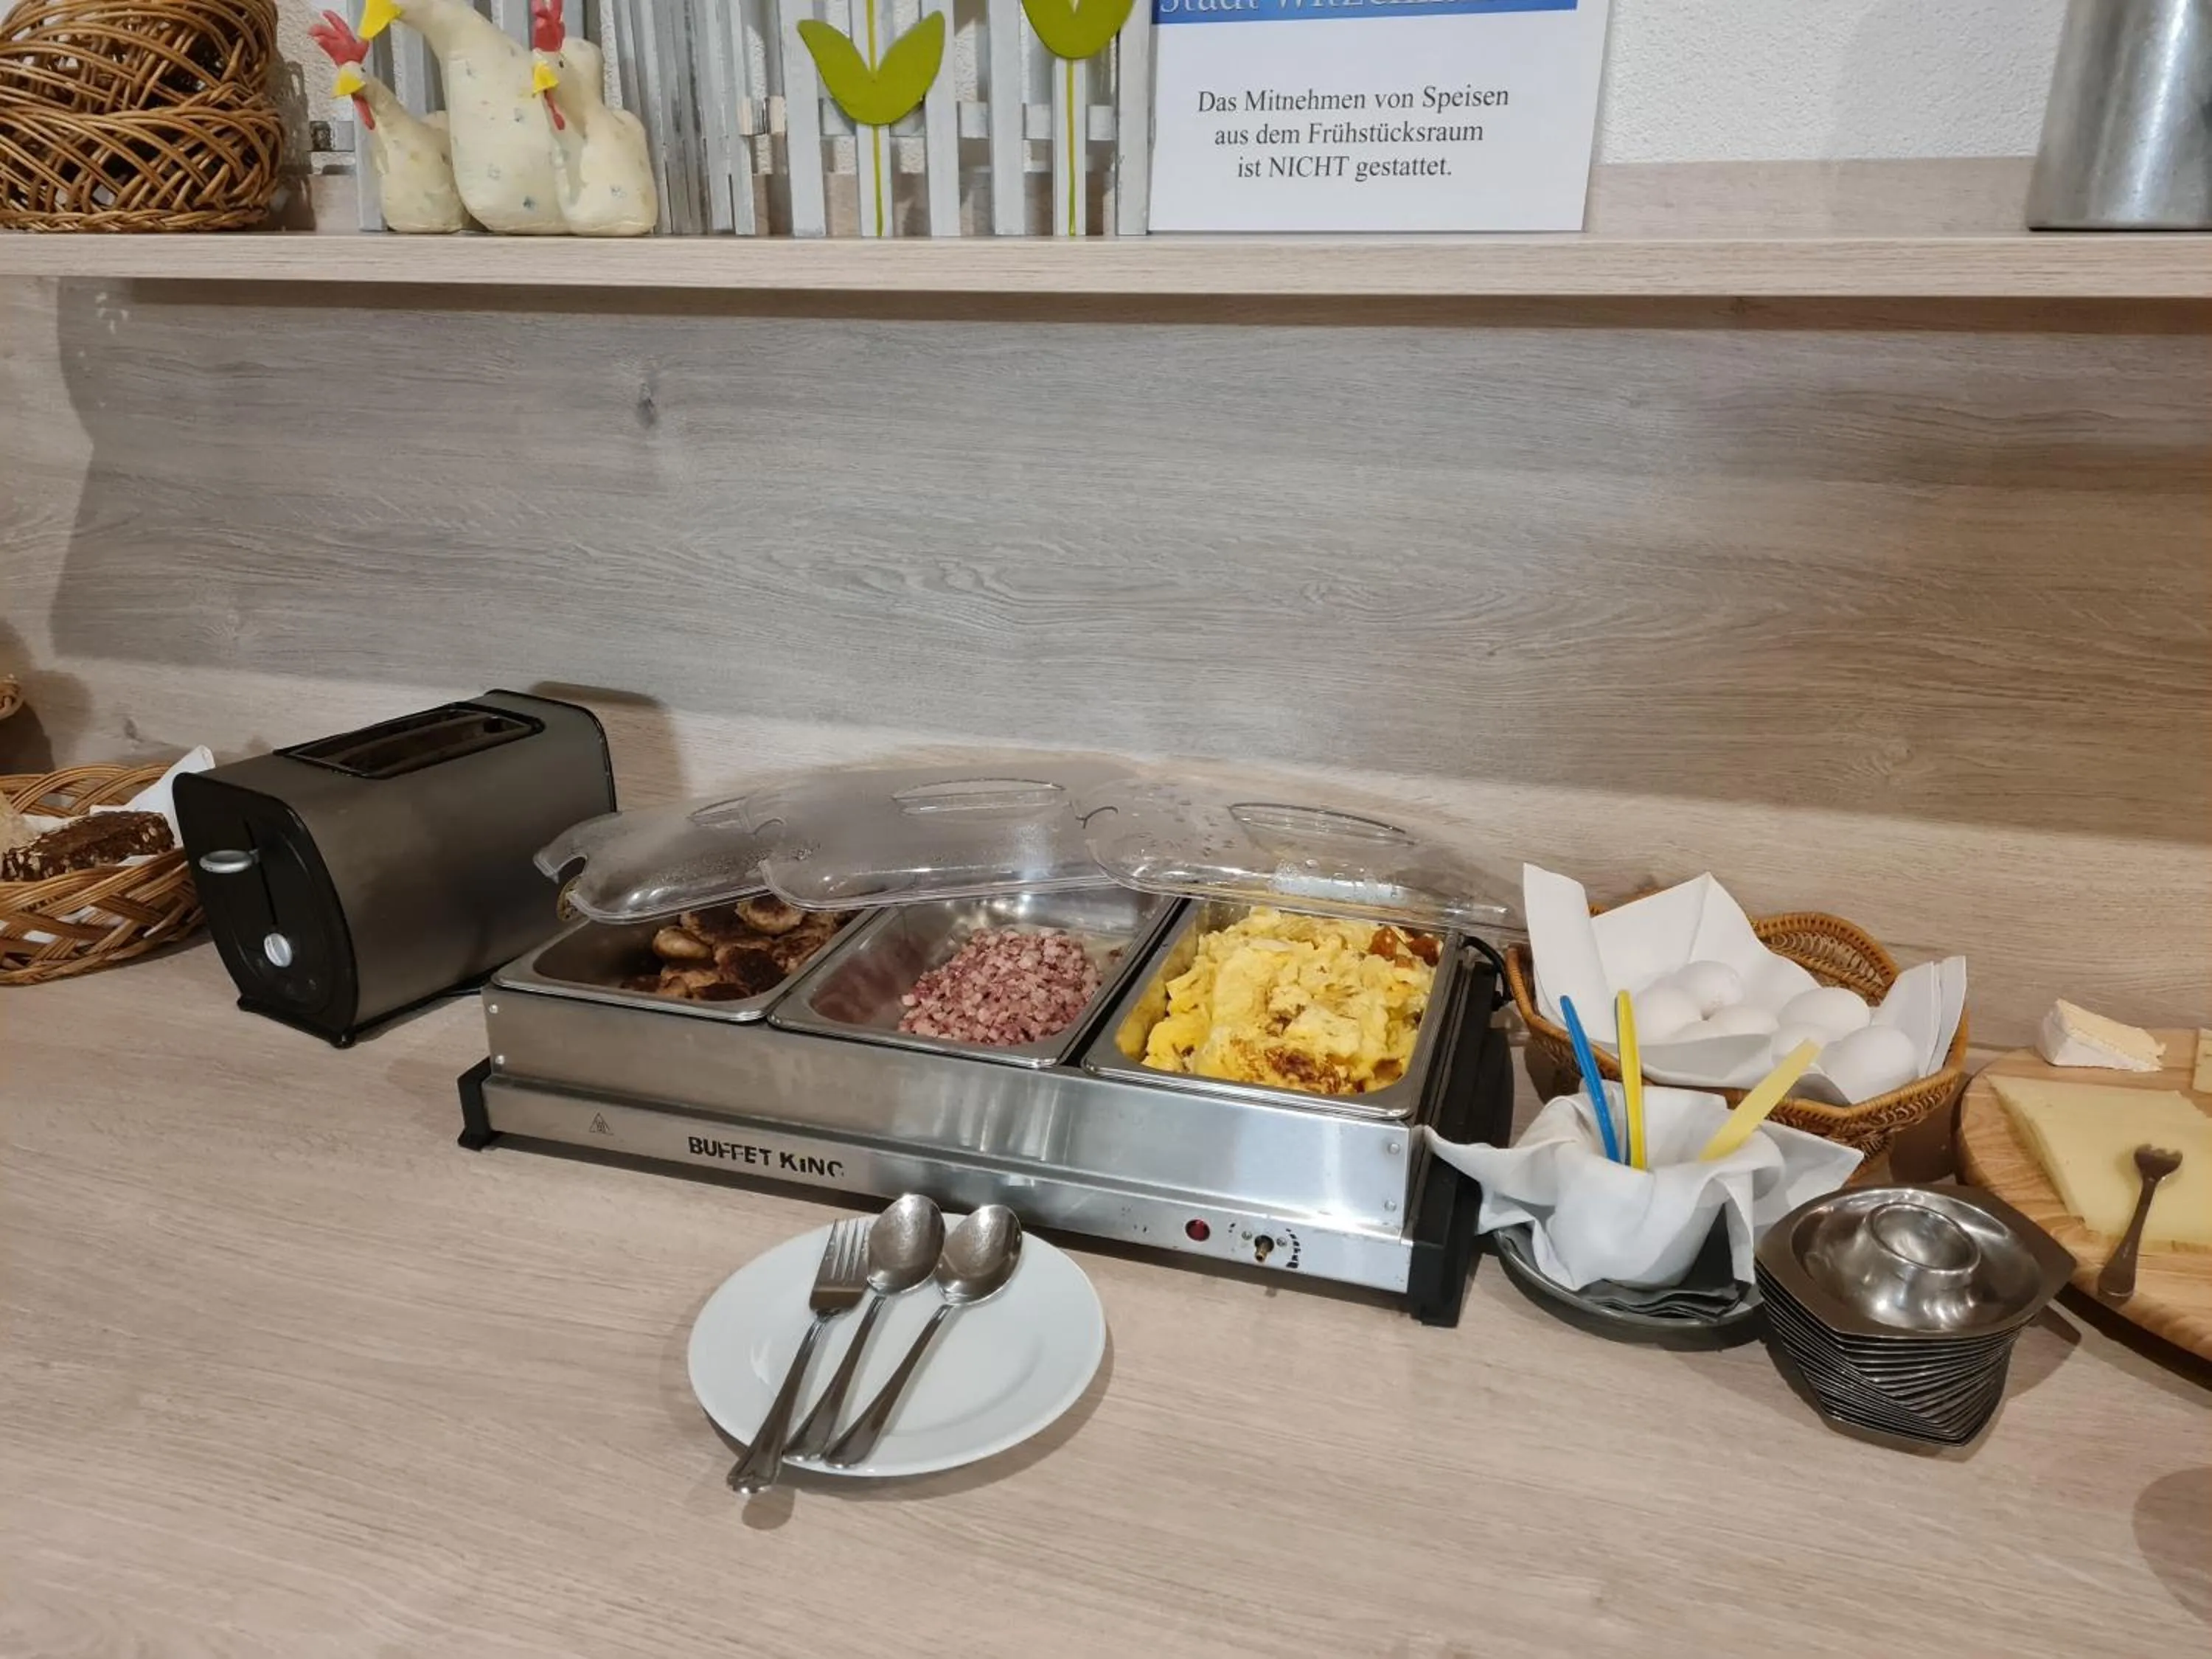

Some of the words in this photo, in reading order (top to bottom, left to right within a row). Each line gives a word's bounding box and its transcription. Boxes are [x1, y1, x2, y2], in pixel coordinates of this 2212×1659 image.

[1197, 90, 1238, 113] Das
[1244, 88, 1366, 112] Mitnehmen
[1374, 93, 1414, 109] von
[1422, 83, 1509, 115] Speisen
[1214, 129, 1249, 146] aus
[1256, 123, 1301, 145] dem
[1308, 120, 1484, 145] Frühstücksraum
[1237, 156, 1262, 178] ist
[1268, 155, 1350, 178] NICHT
[1354, 158, 1453, 183] gestattet.
[687, 1135, 773, 1166] BUFFET
